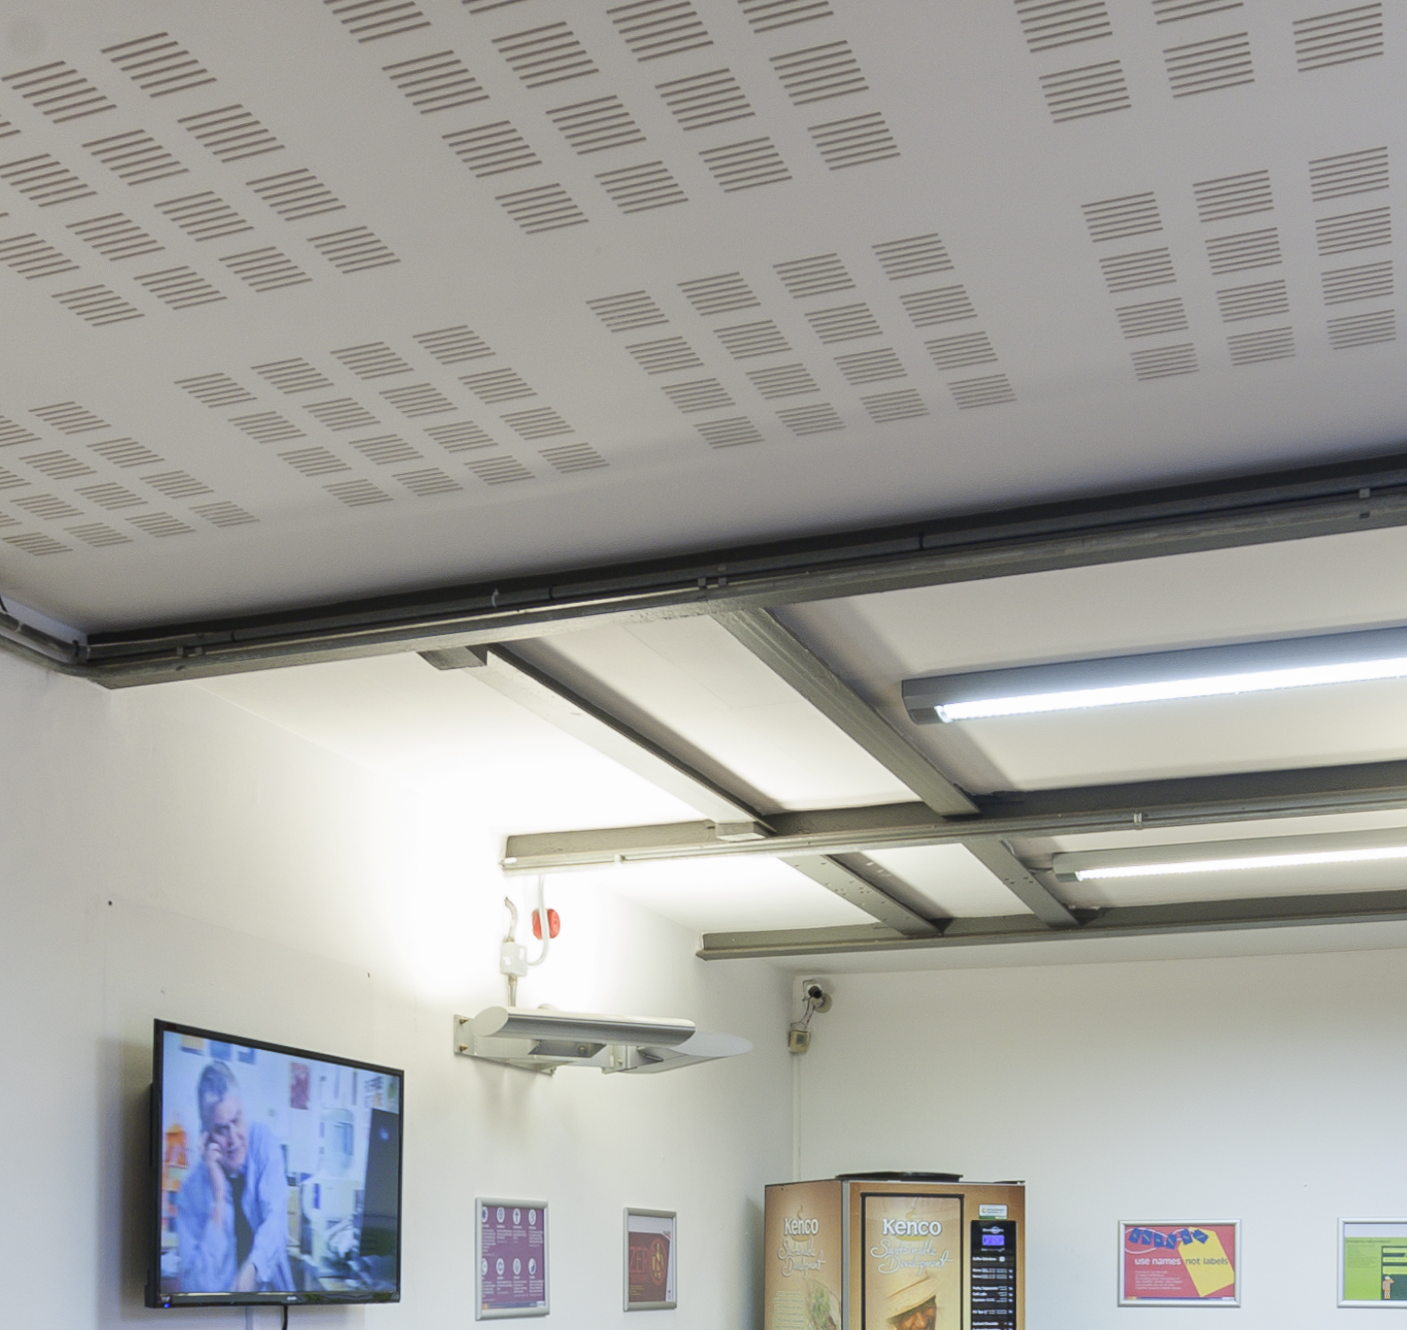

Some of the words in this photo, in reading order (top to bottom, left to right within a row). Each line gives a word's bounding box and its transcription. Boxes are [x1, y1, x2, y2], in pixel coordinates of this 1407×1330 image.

[783, 1217, 819, 1236] Kenco
[882, 1218, 942, 1237] Kenco
[1134, 1258, 1150, 1266] use
[1152, 1257, 1181, 1266] names
[1185, 1257, 1201, 1265] not
[1203, 1257, 1228, 1265] labels
